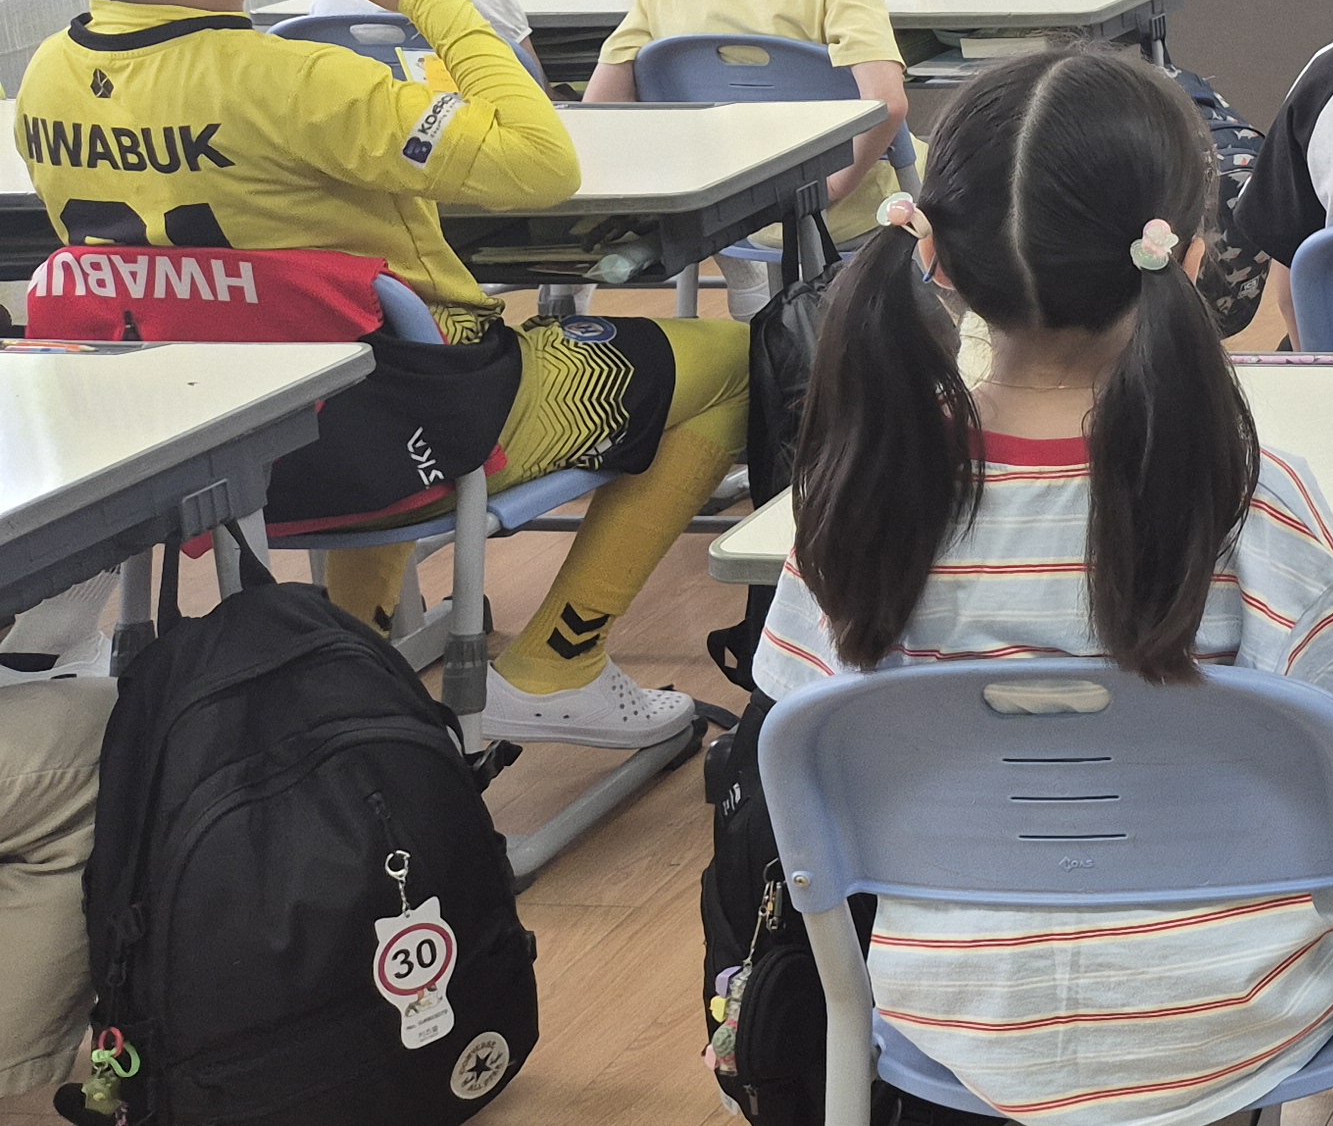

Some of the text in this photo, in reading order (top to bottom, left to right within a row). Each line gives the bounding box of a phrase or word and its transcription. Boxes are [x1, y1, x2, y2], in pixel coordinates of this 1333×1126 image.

[22, 113, 235, 174] HWABUK
[28, 253, 258, 304] HWABUK
[391, 938, 437, 980] 30
